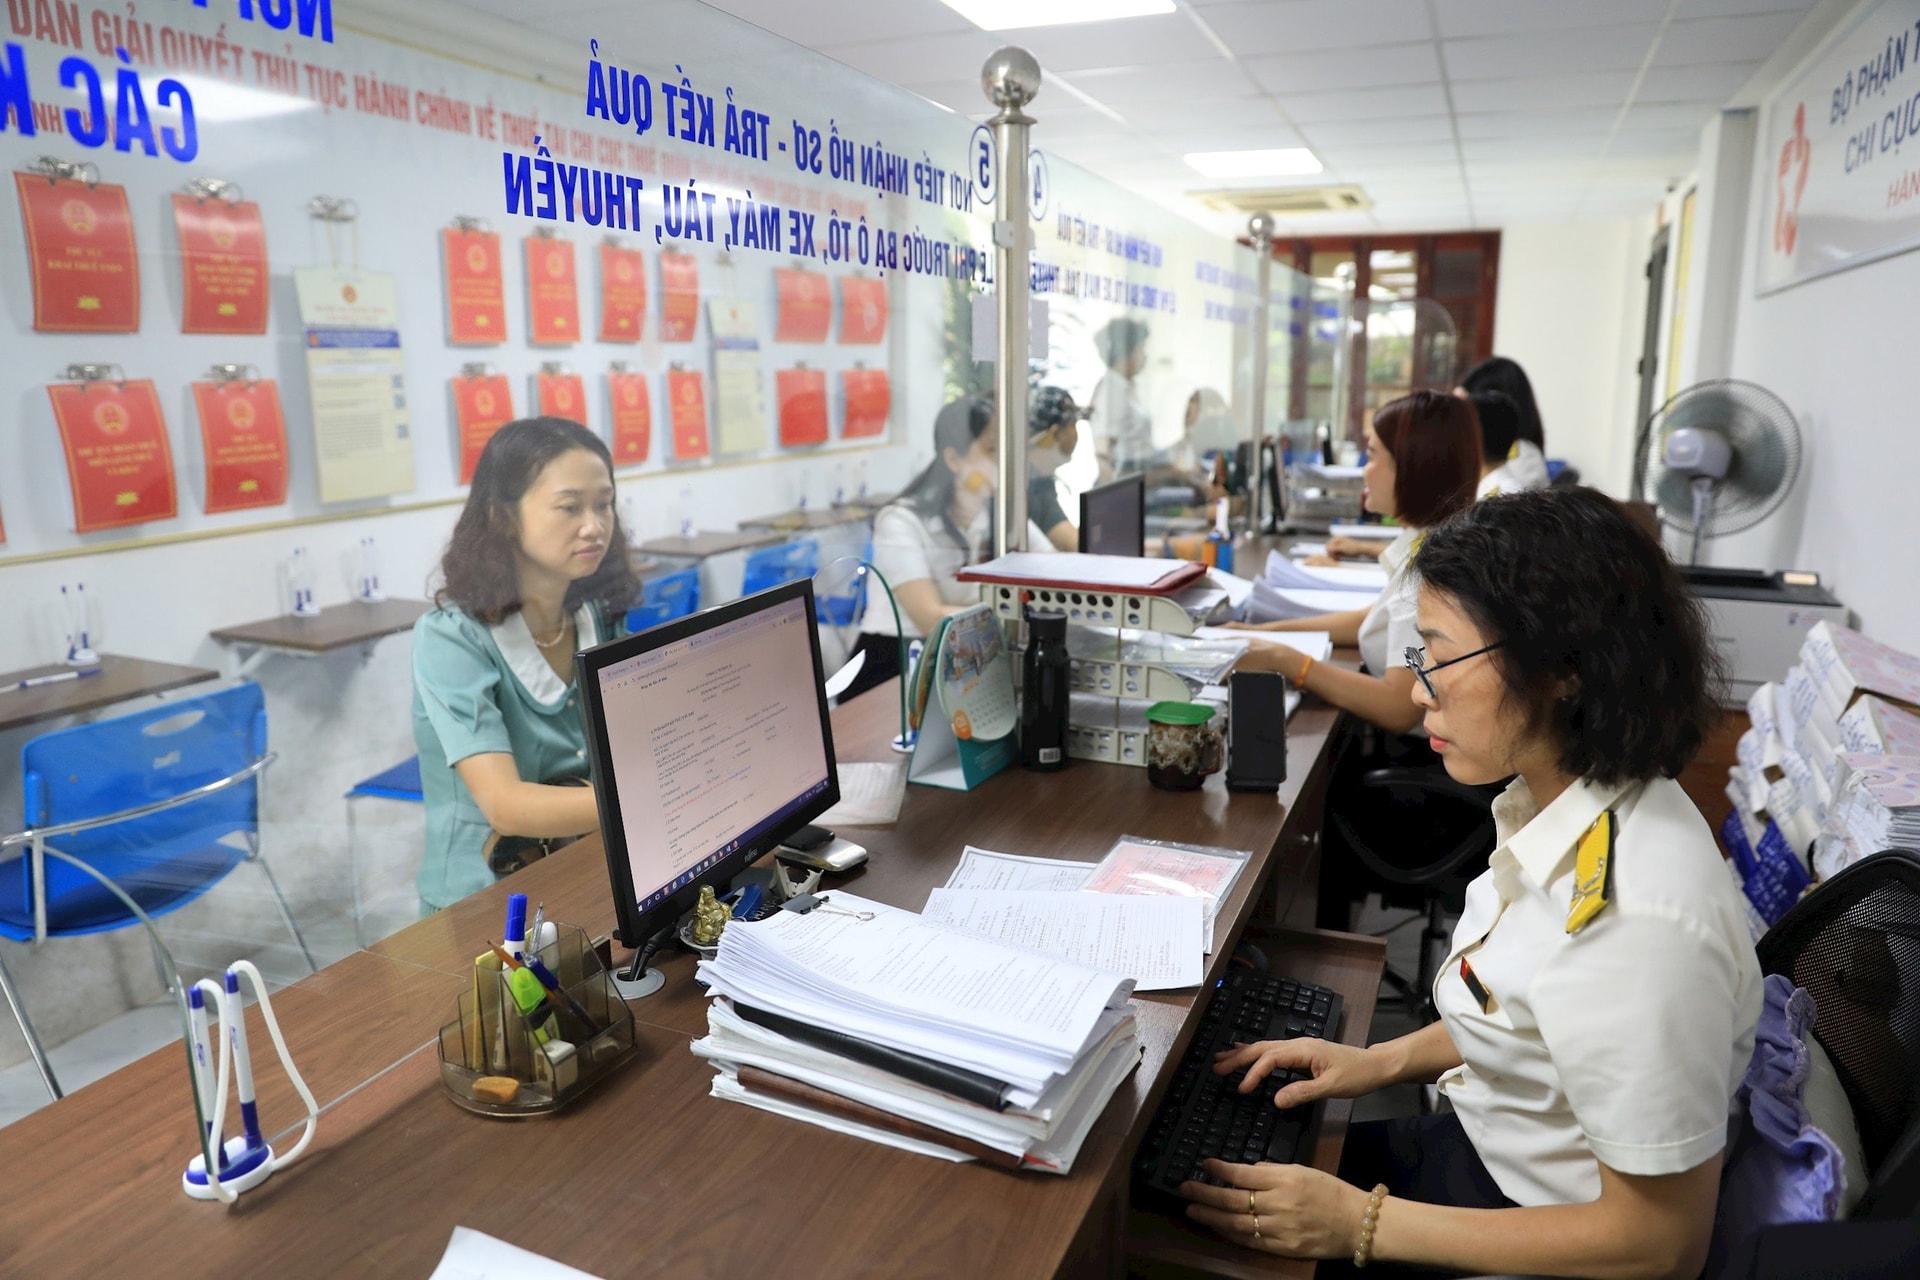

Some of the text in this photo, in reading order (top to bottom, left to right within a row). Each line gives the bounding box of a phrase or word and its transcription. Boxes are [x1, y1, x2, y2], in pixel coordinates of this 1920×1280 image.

[93, 2, 155, 68] GIẢI
[160, 23, 244, 82] QUYẾT
[250, 41, 299, 96] THỦ
[353, 67, 411, 121] HÀNH
[1829, 70, 1853, 125] BỘ
[1855, 30, 1910, 105] PHẬN
[1845, 90, 1920, 174] CHI CỤC
